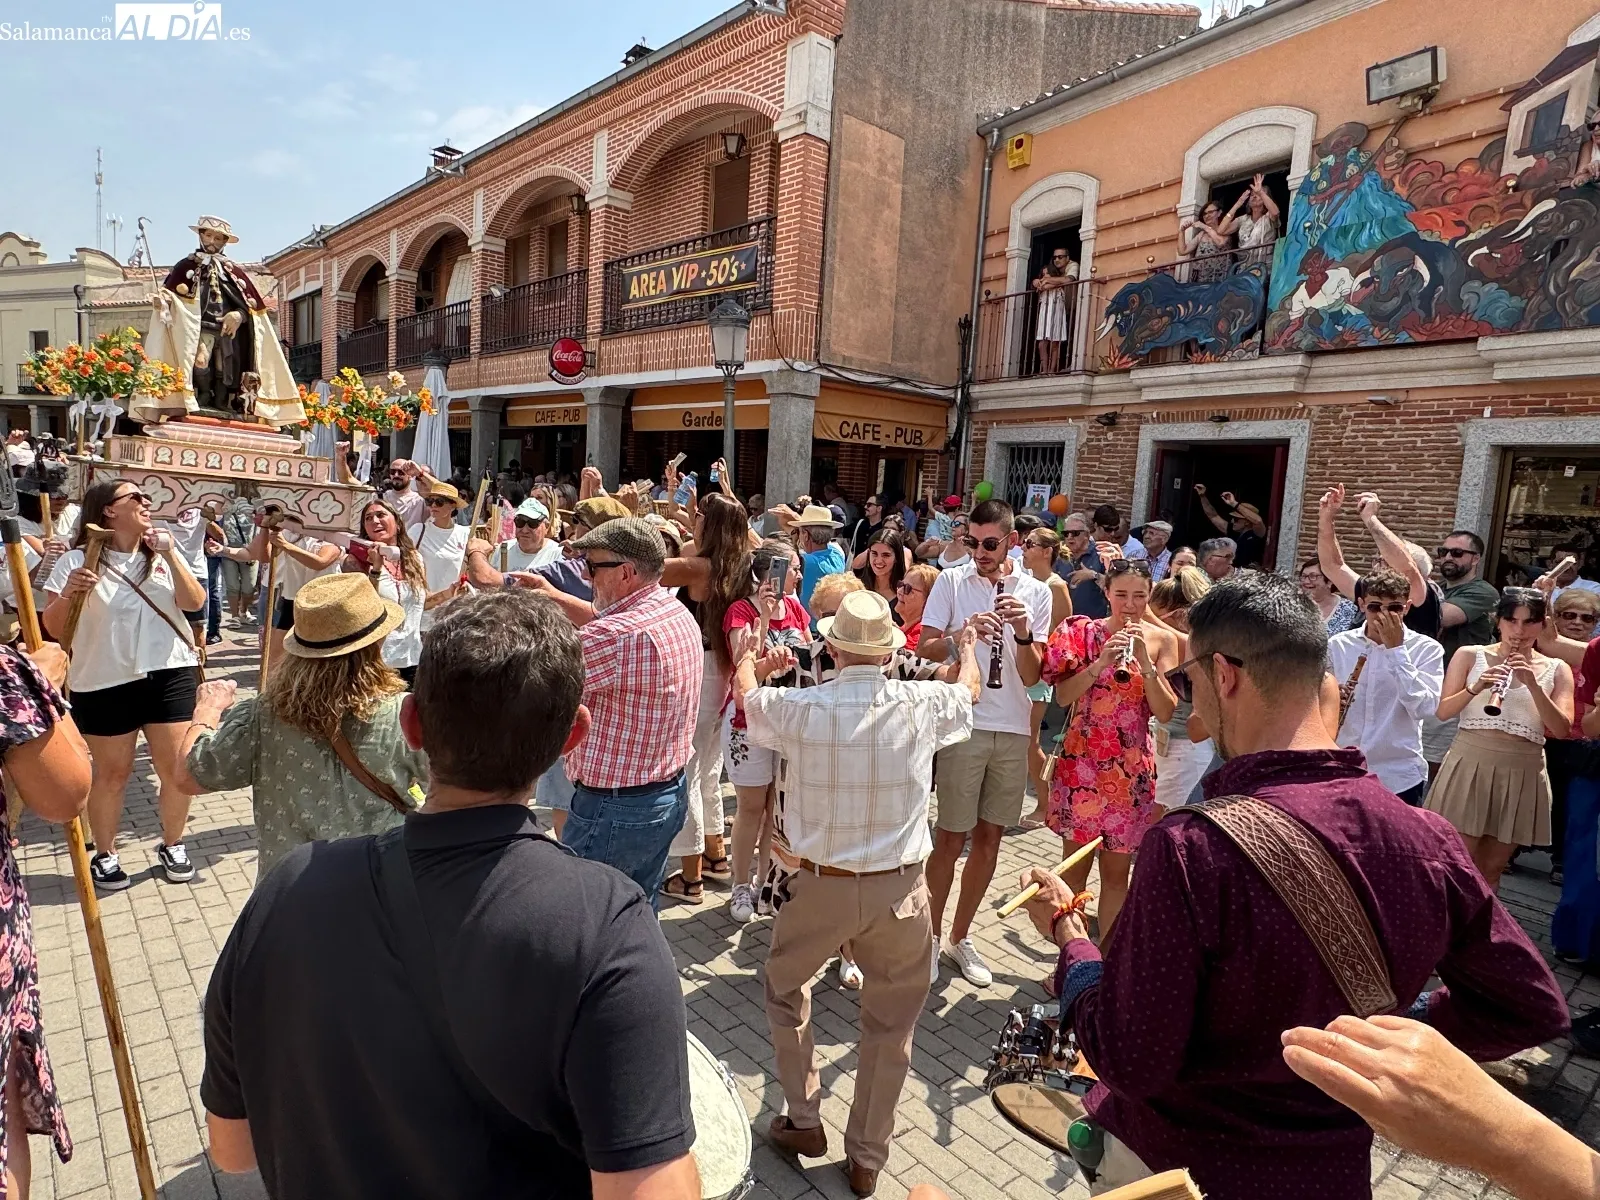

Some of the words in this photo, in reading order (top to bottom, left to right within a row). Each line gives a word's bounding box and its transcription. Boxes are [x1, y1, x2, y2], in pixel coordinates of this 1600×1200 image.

[629, 270, 667, 299] AREA
[672, 263, 699, 290] VIP
[706, 255, 739, 286] 50's
[535, 410, 556, 423] CAFE
[563, 409, 580, 422] PUB
[682, 410, 726, 427] Garde
[839, 420, 881, 441] CAFE
[894, 427, 923, 446] PUB
